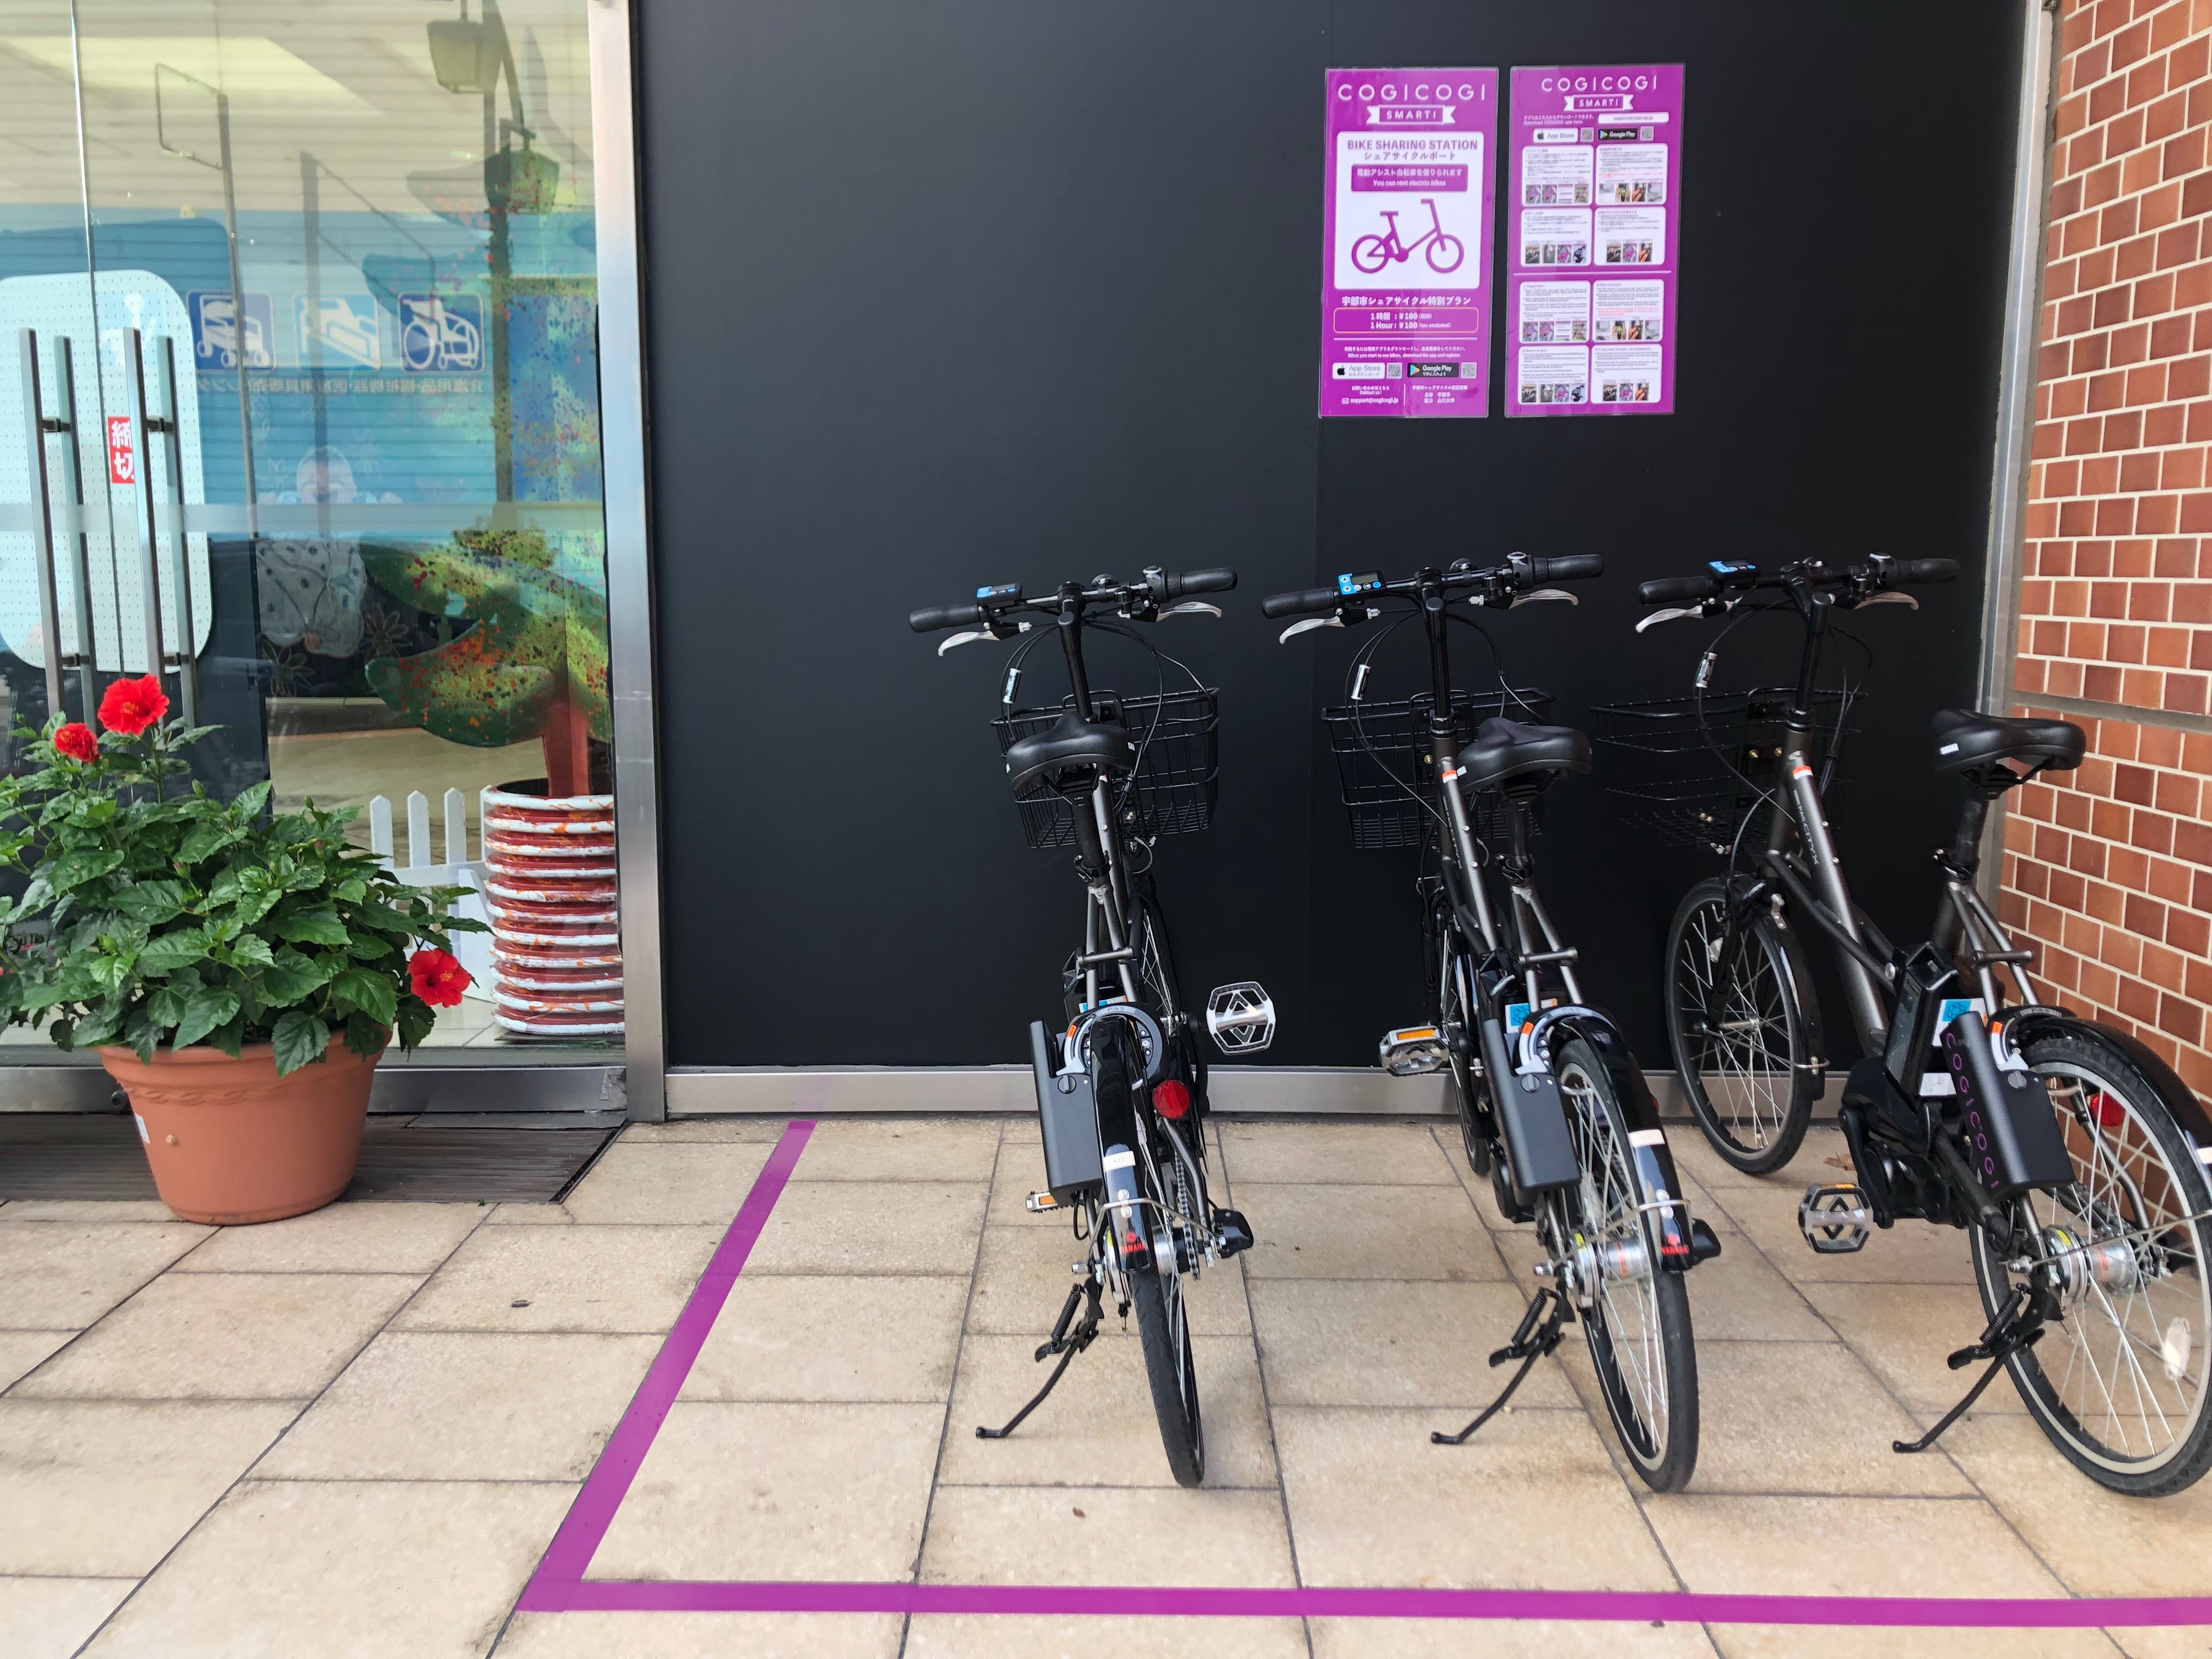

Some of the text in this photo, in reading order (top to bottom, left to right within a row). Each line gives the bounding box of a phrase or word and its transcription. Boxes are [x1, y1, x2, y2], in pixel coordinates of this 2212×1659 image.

[1338, 83, 1486, 101] COGICOGI
[1542, 75, 1657, 92] COGICOGI
[1347, 139, 1477, 150] BIKE SHARING STATION
[1364, 151, 1455, 161] シェアサイクルポート
[1946, 1032, 2000, 1188] COGICOGI
